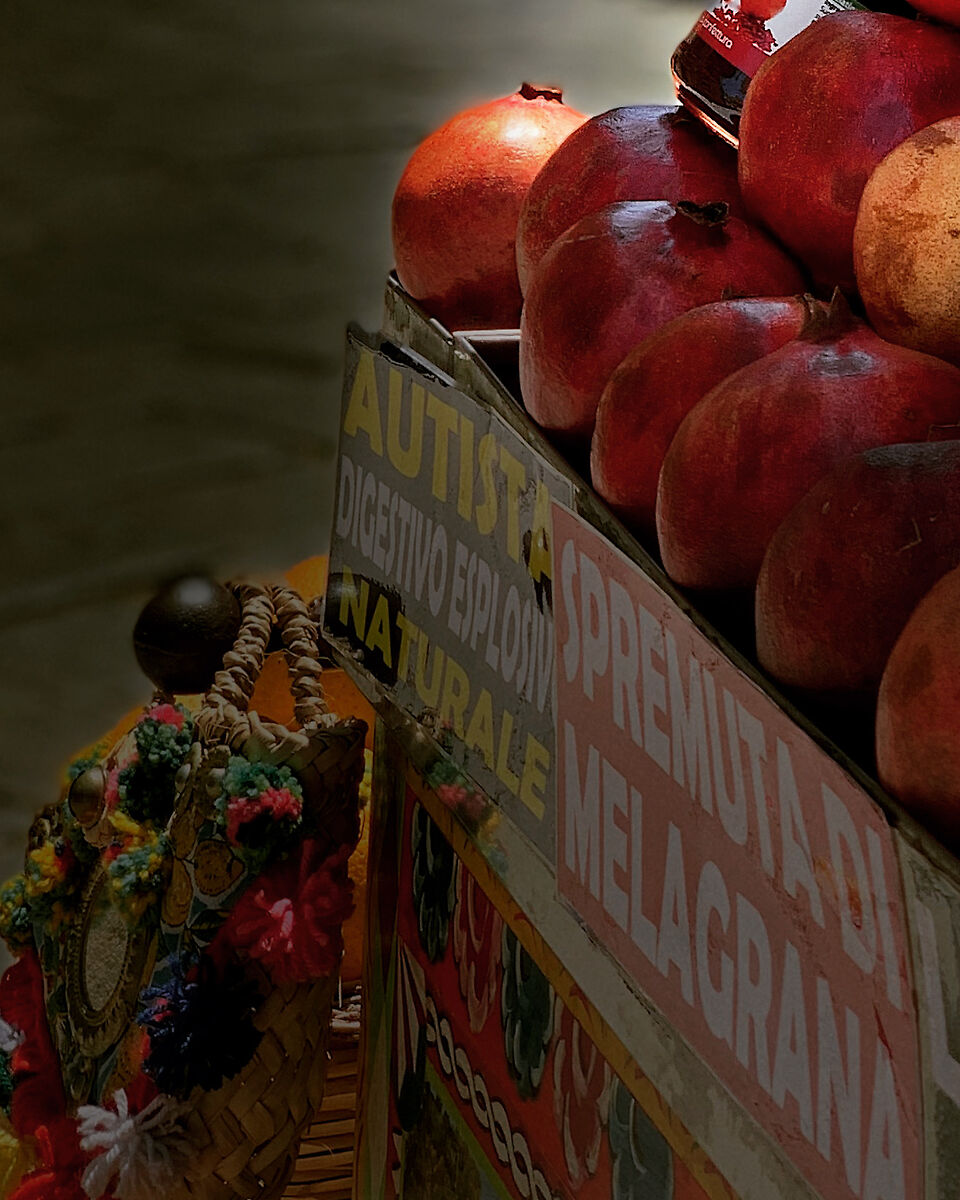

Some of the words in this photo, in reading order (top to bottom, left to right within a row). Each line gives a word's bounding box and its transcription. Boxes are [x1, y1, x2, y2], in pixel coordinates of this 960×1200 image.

[336, 455, 447, 611] DIGESTIVO
[344, 349, 553, 583] AUTISTA
[339, 567, 551, 820] NATURALE
[561, 539, 825, 929] SPREMUTA
[822, 781, 903, 1011] DI
[565, 720, 907, 1200] MELAGRANA
